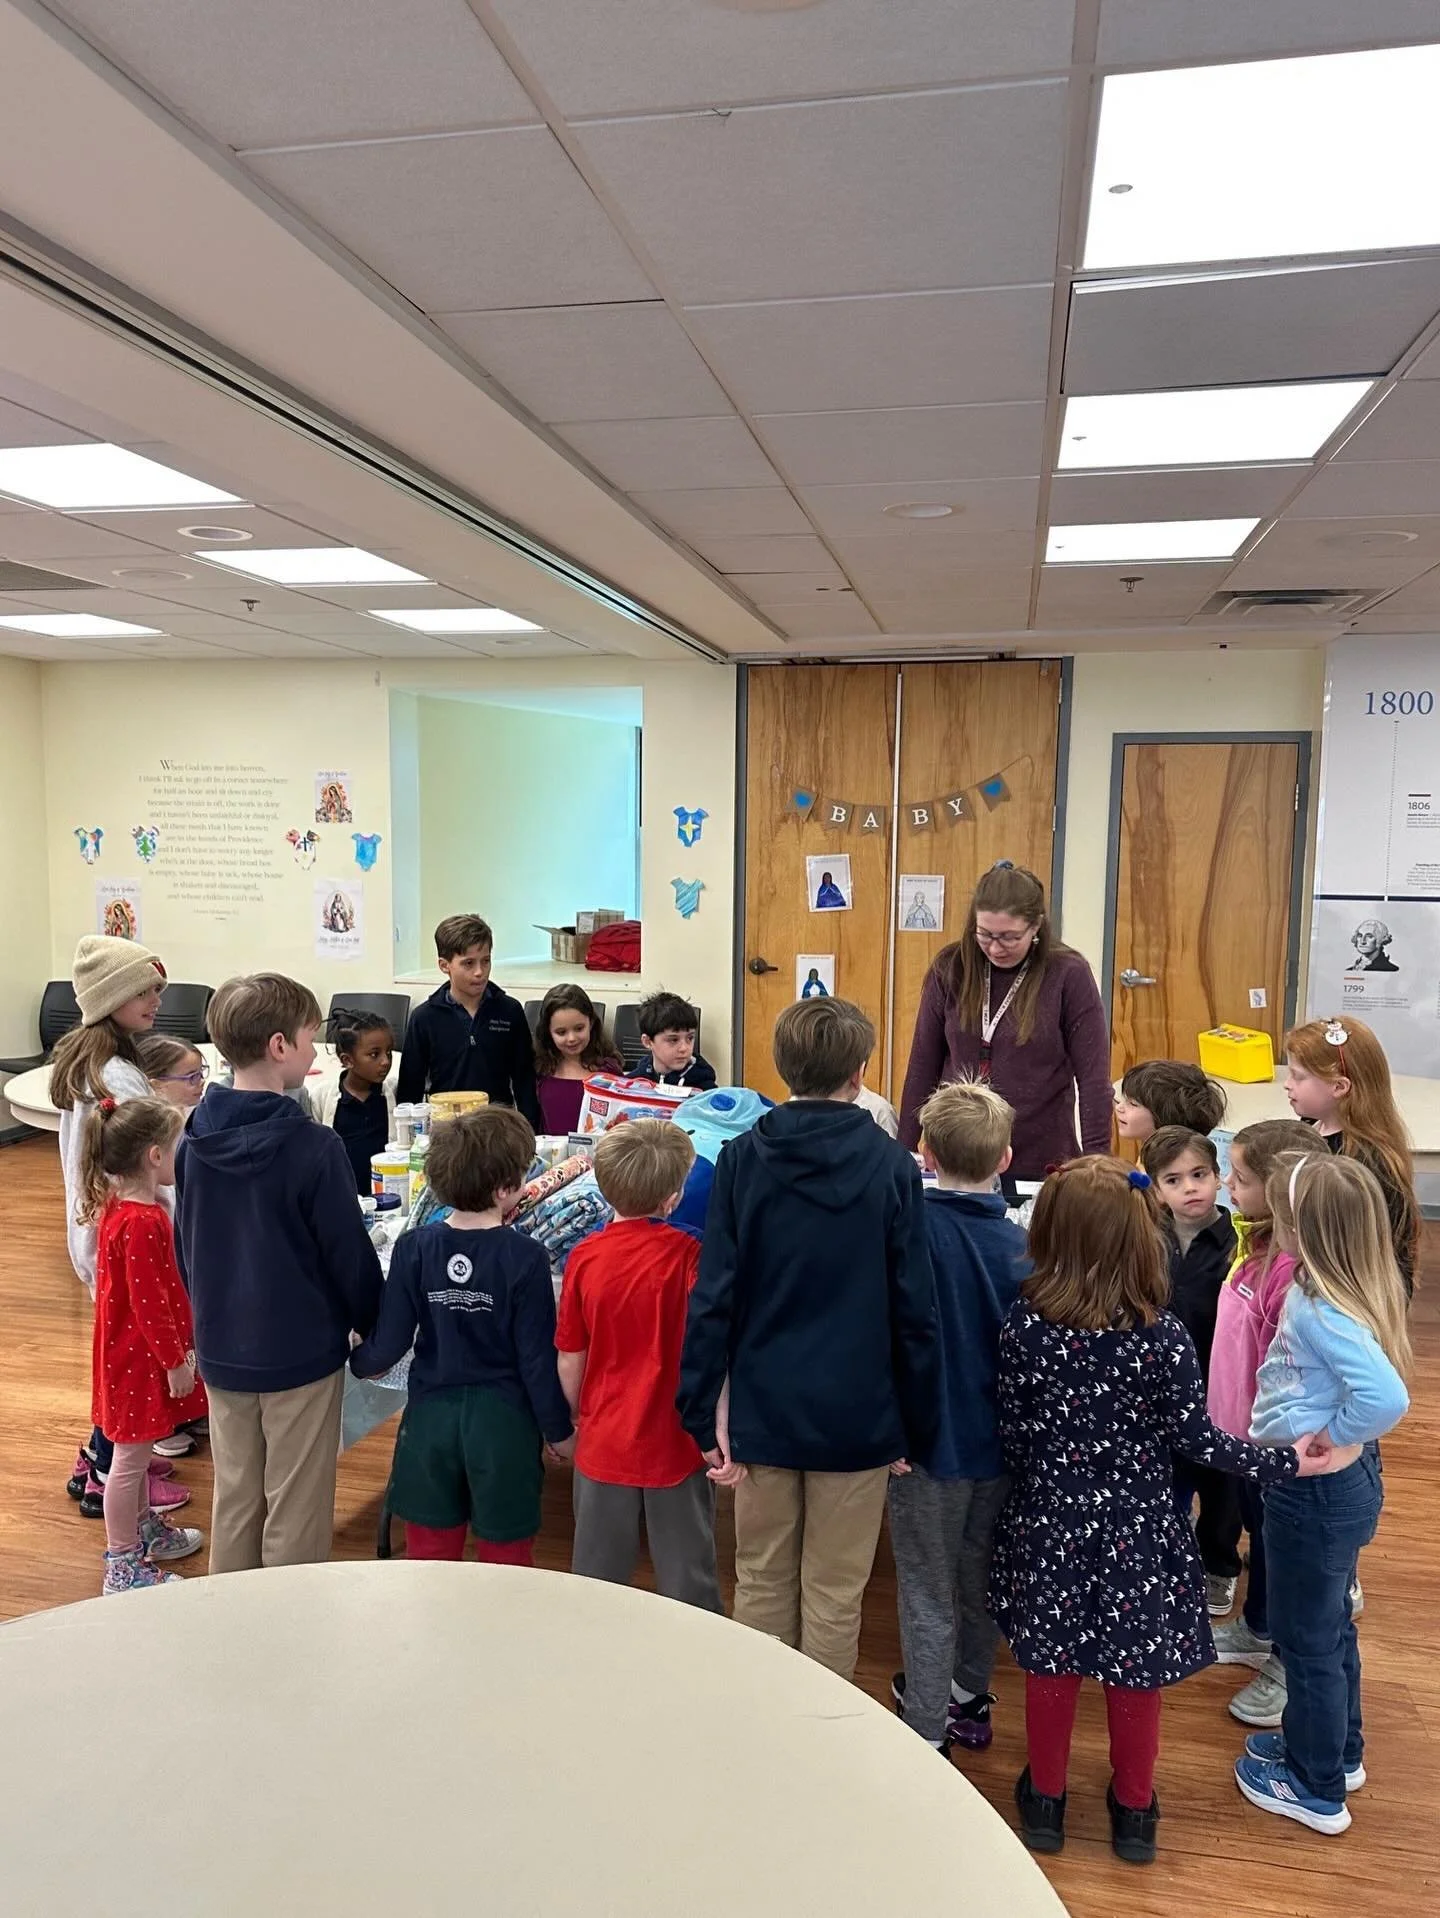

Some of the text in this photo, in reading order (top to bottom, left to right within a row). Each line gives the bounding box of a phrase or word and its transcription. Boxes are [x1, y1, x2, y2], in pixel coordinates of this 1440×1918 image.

[1364, 690, 1434, 716] 1800
[1408, 801, 1431, 810] 1806
[1343, 984, 1365, 993] 1799
